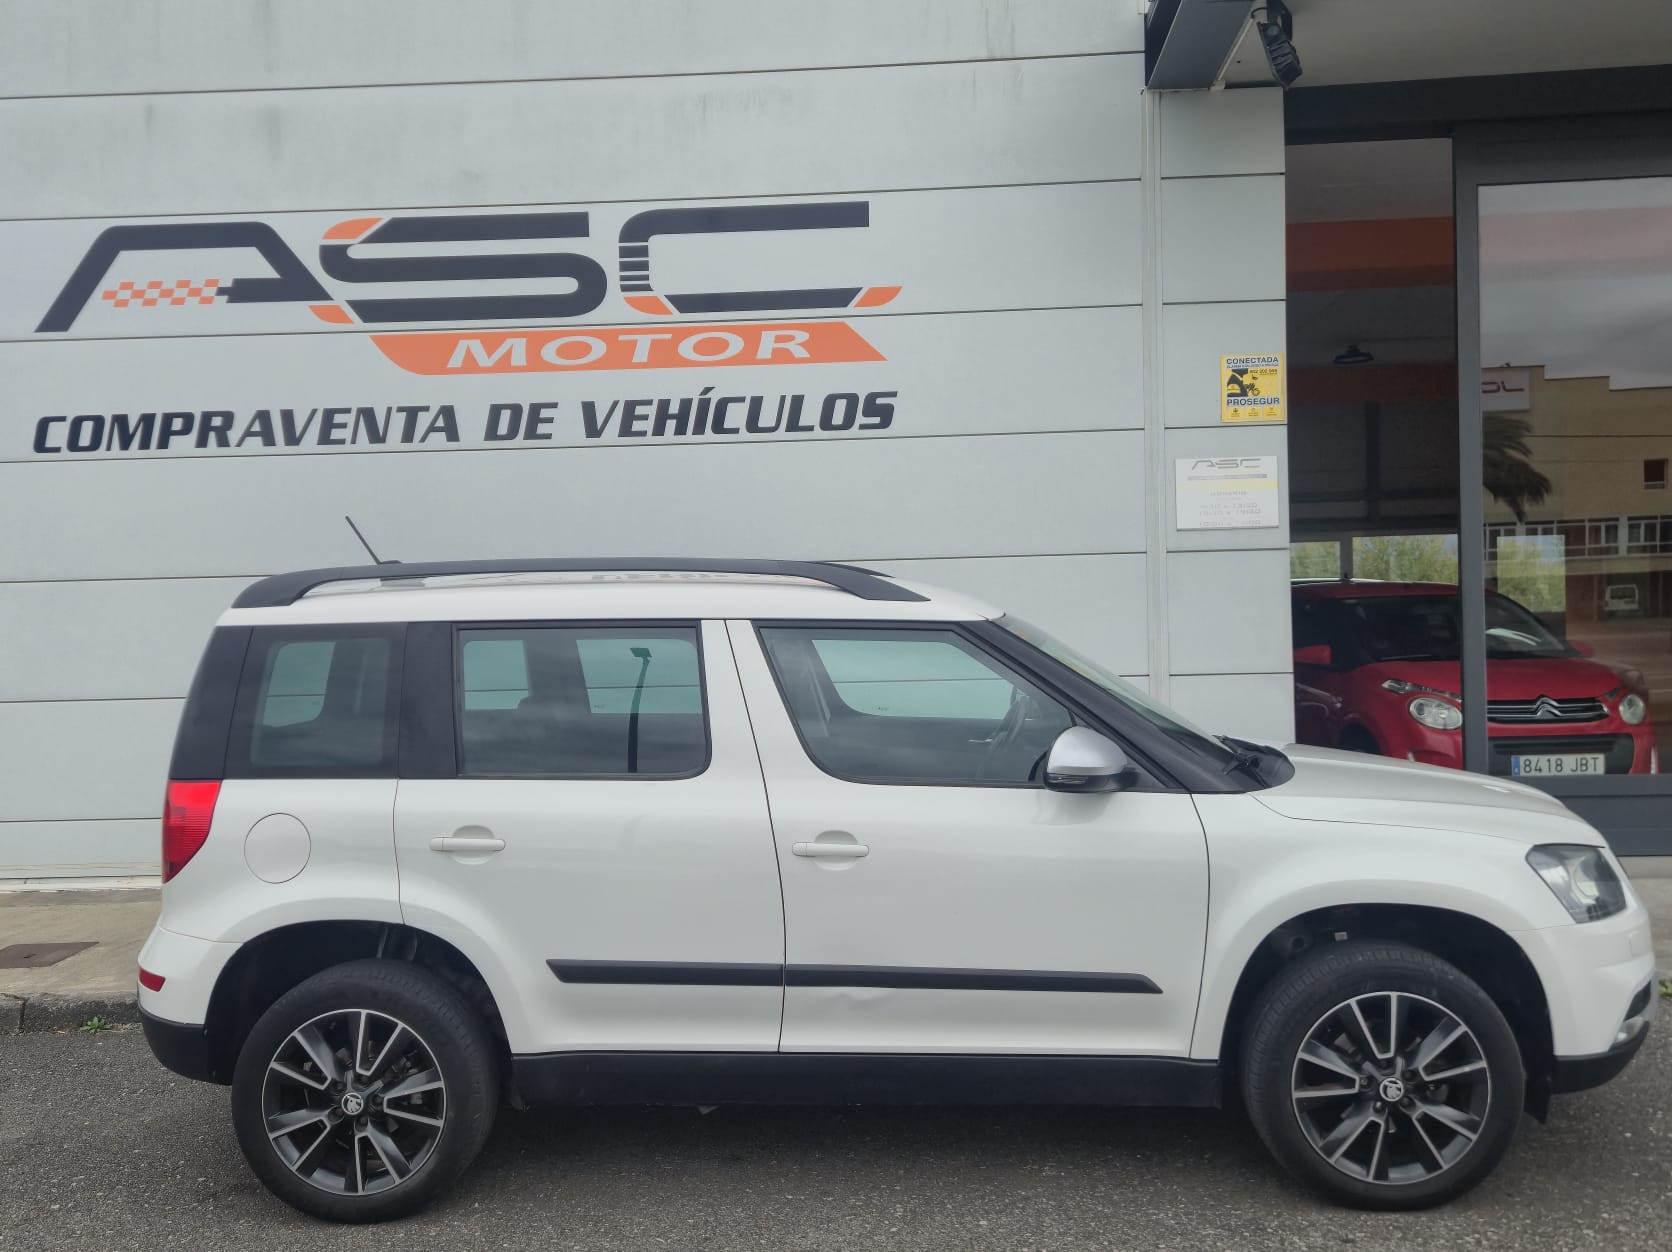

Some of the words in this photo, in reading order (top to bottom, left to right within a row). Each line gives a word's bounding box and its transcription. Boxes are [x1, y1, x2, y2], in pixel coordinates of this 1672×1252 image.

[35, 201, 901, 332] ASC
[448, 328, 810, 369] MOTOR
[1226, 356, 1279, 365] CONECTADA
[1226, 397, 1280, 406] PROSEGUR
[34, 405, 460, 453] COMPRAVENTA
[484, 402, 558, 441] DE
[582, 387, 898, 439] VEHÍCULOS
[1191, 457, 1262, 471] ASC
[1523, 757, 1564, 774] 8418
[1570, 756, 1600, 773] JBT
